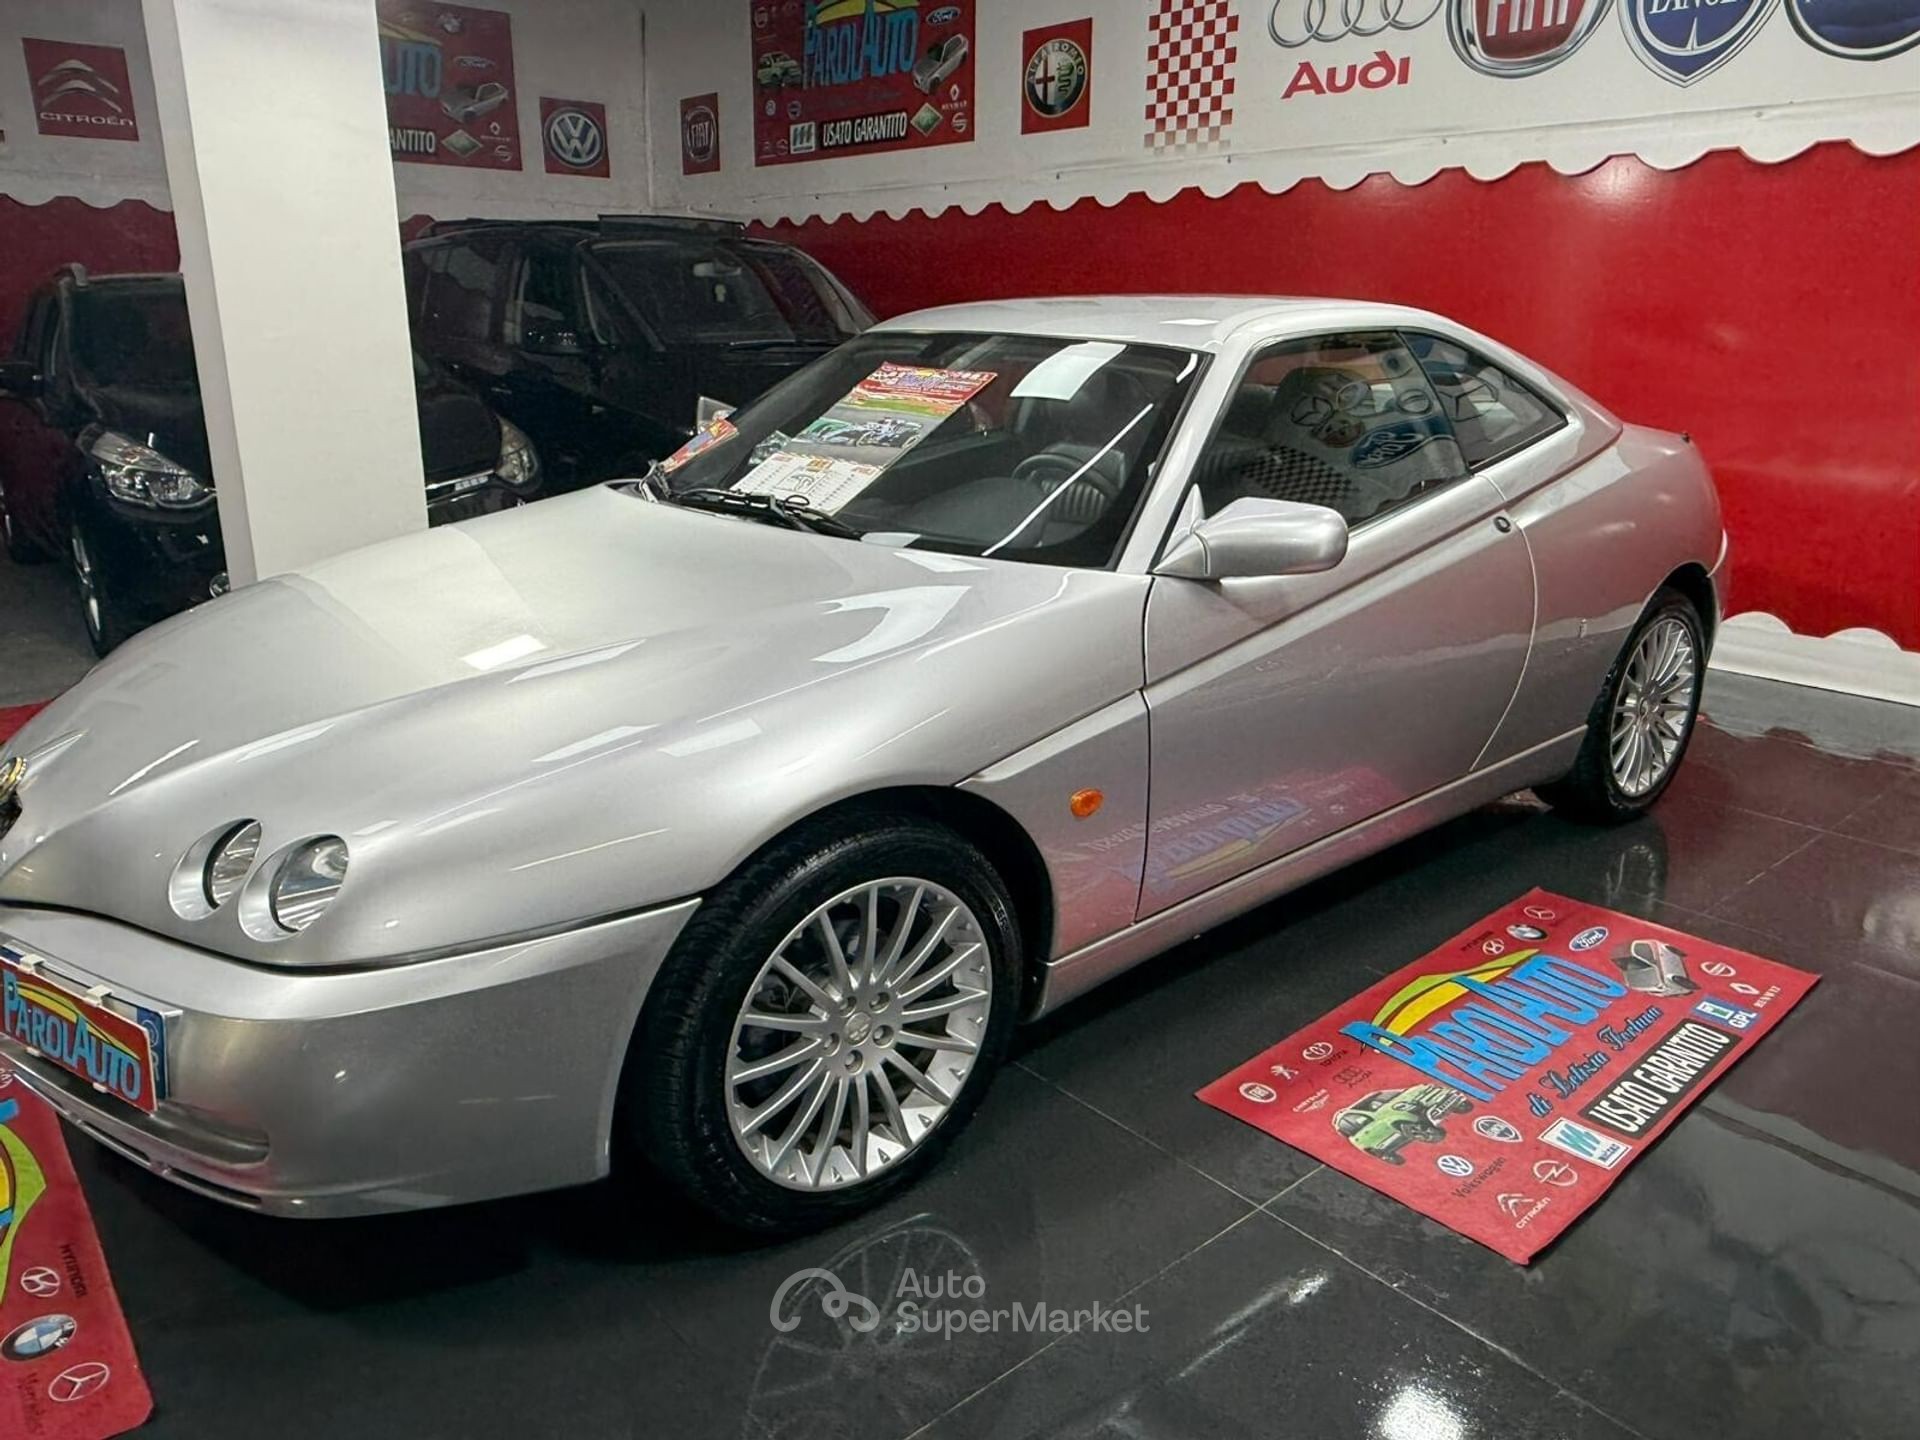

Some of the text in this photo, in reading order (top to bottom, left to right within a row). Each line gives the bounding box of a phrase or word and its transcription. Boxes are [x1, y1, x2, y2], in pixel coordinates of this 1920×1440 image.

[823, 112, 908, 147] USATO GARANTITO
[1728, 1010, 1758, 1029] GPL
[1588, 1022, 1731, 1133] USATO GARANTITO
